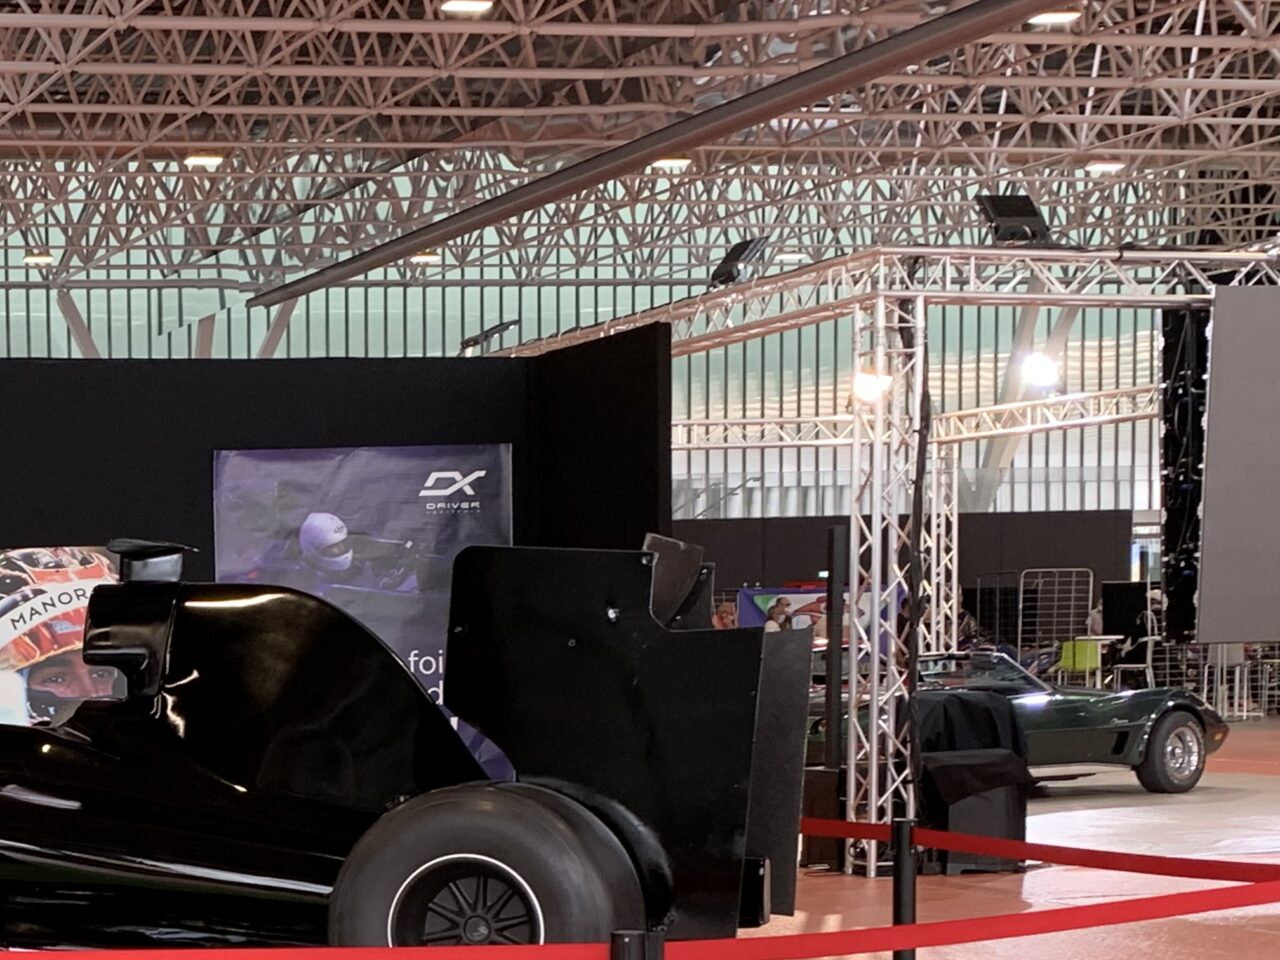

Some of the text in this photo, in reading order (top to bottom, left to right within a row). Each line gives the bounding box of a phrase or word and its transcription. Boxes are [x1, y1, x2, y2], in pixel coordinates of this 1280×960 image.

[425, 501, 480, 510] DRIVER
[10, 588, 89, 630] MANOR
[408, 649, 444, 675] foi
